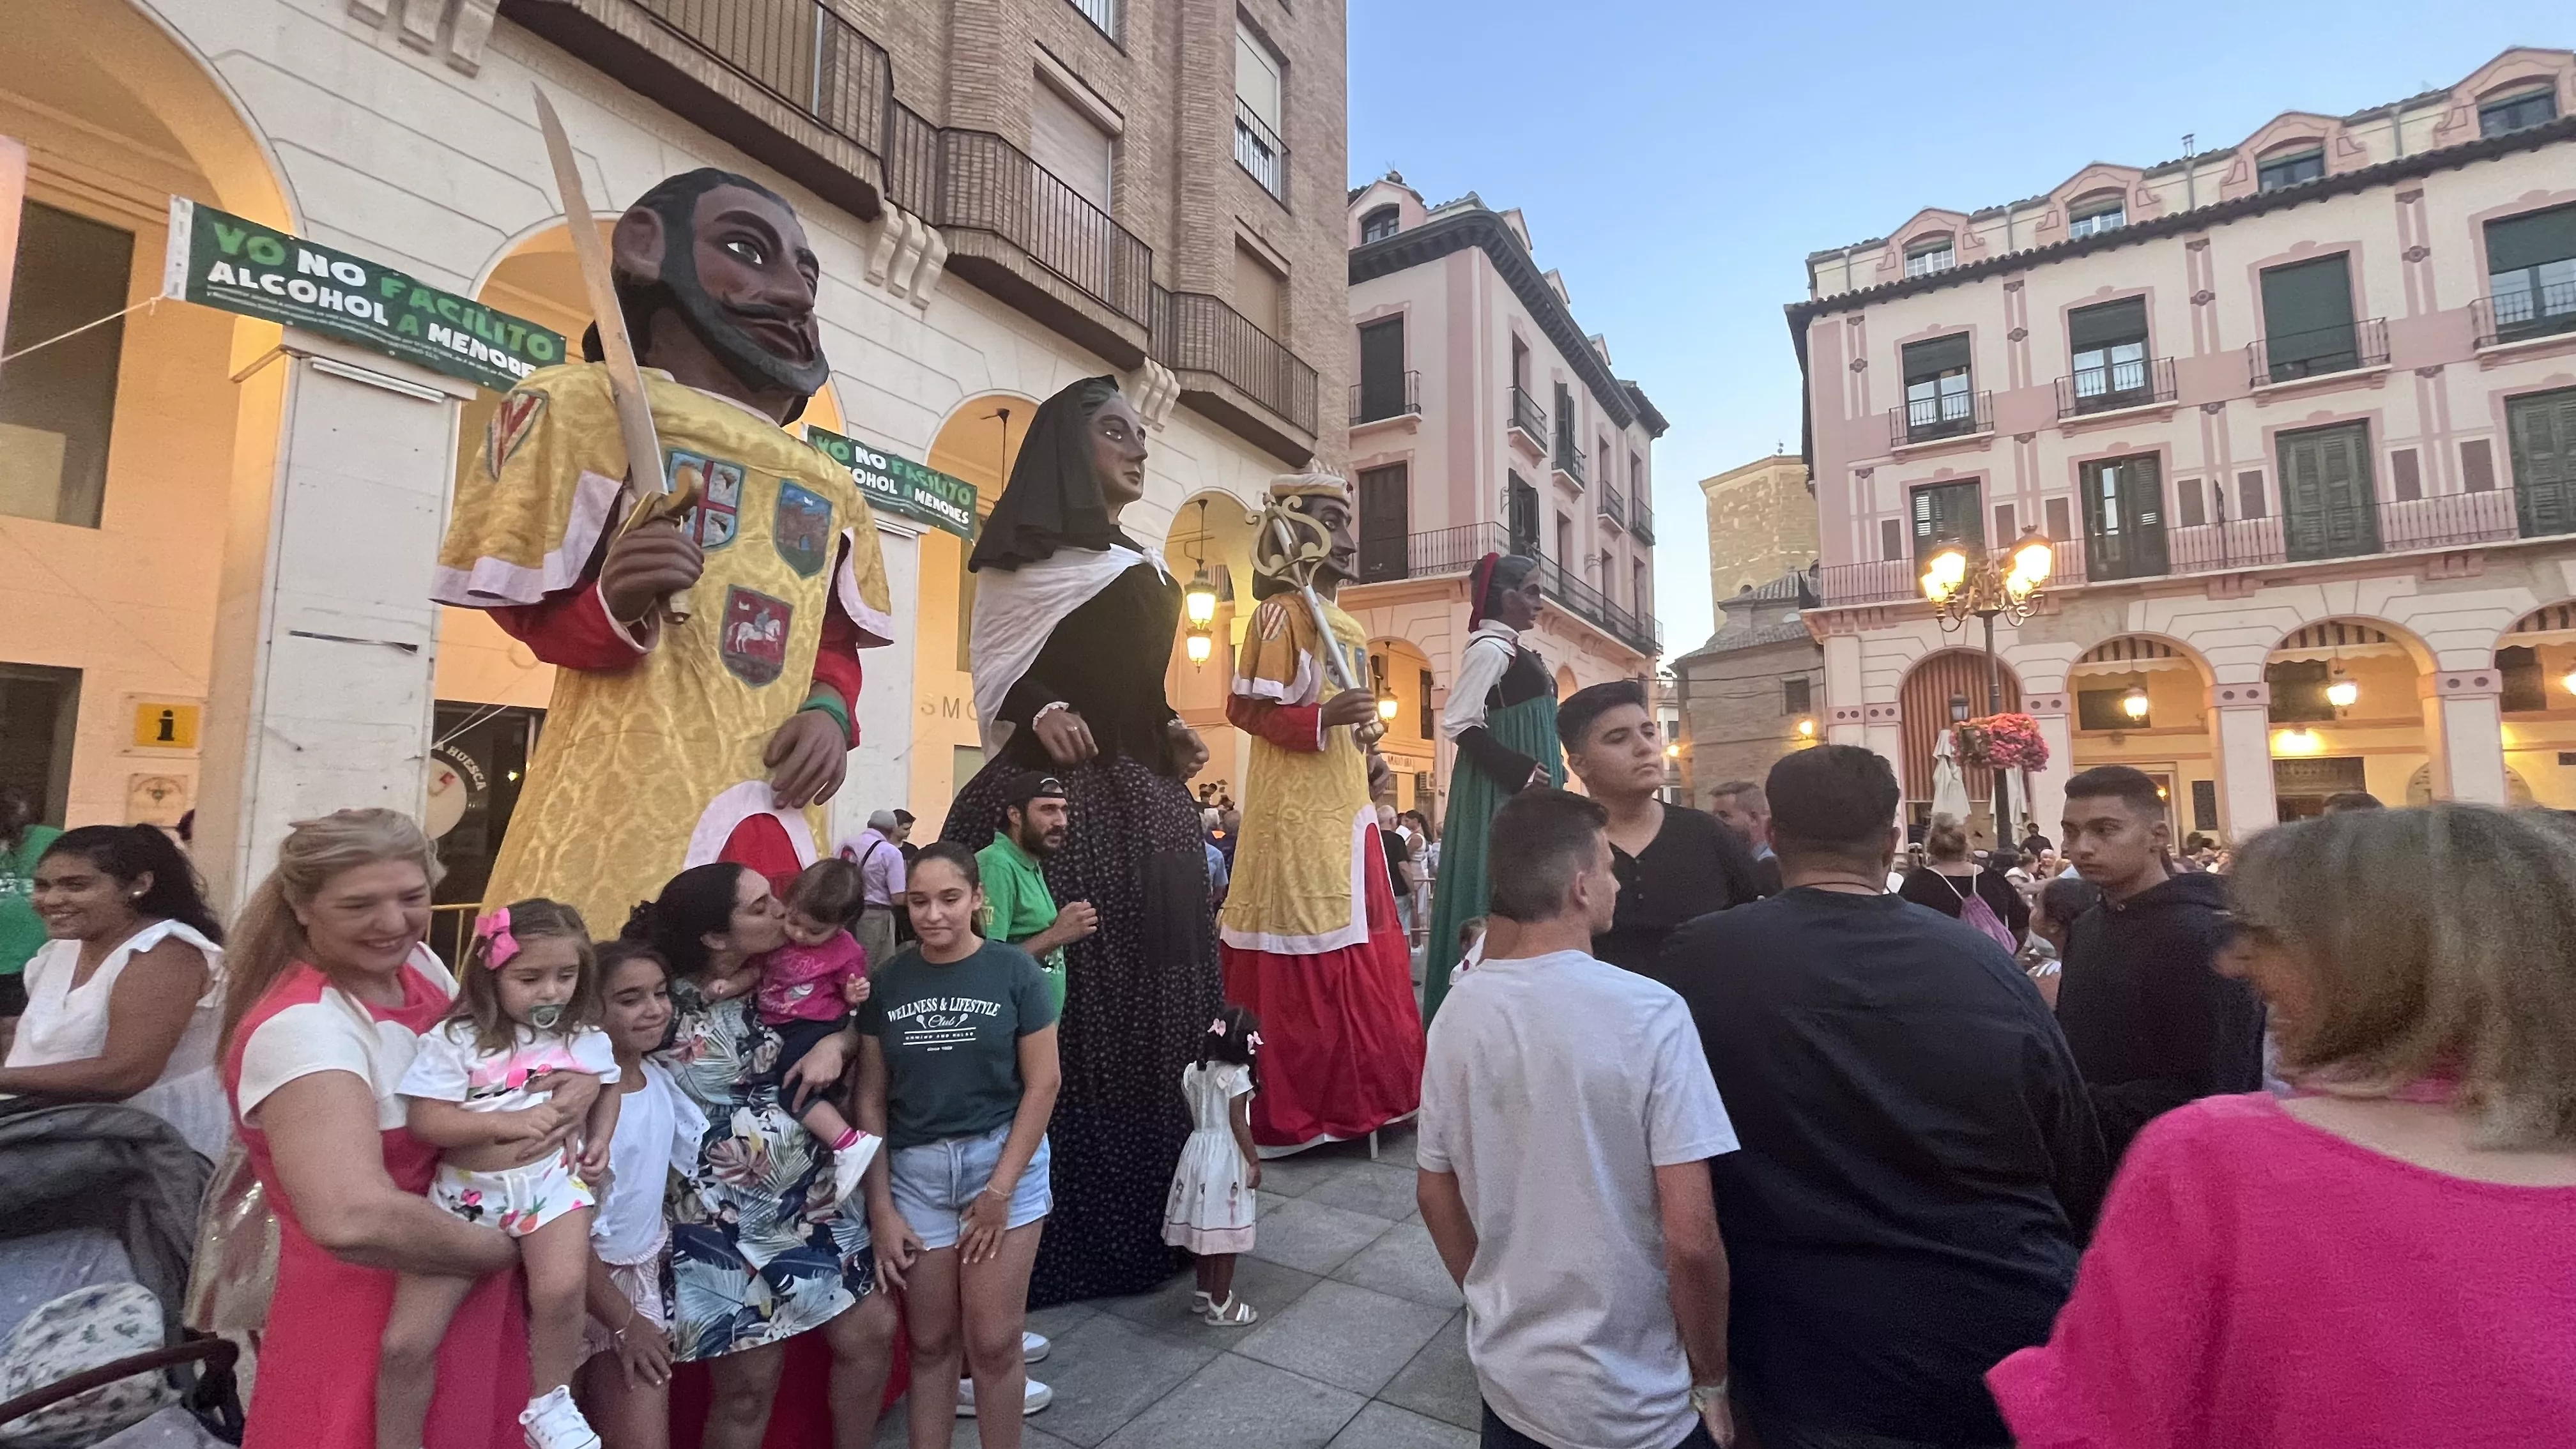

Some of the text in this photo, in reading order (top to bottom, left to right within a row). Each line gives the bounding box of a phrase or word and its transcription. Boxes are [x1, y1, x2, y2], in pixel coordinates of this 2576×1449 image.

[206, 260, 389, 327] ALCOHOL
[395, 314, 420, 337] A
[427, 322, 537, 379] MENORE
[214, 222, 286, 266] YO
[297, 247, 367, 288] NO
[380, 276, 554, 361] FACILITO
[815, 435, 850, 461] YO
[854, 445, 887, 470] NO
[891, 459, 971, 506] FACILITO
[843, 465, 898, 495] OHOL
[901, 484, 913, 498] A
[914, 487, 970, 525] MENORES
[446, 745, 487, 792] HUESCA
[887, 997, 1001, 1023] WELLNESS & LIFESTYLE
[928, 1014, 956, 1029] Club
